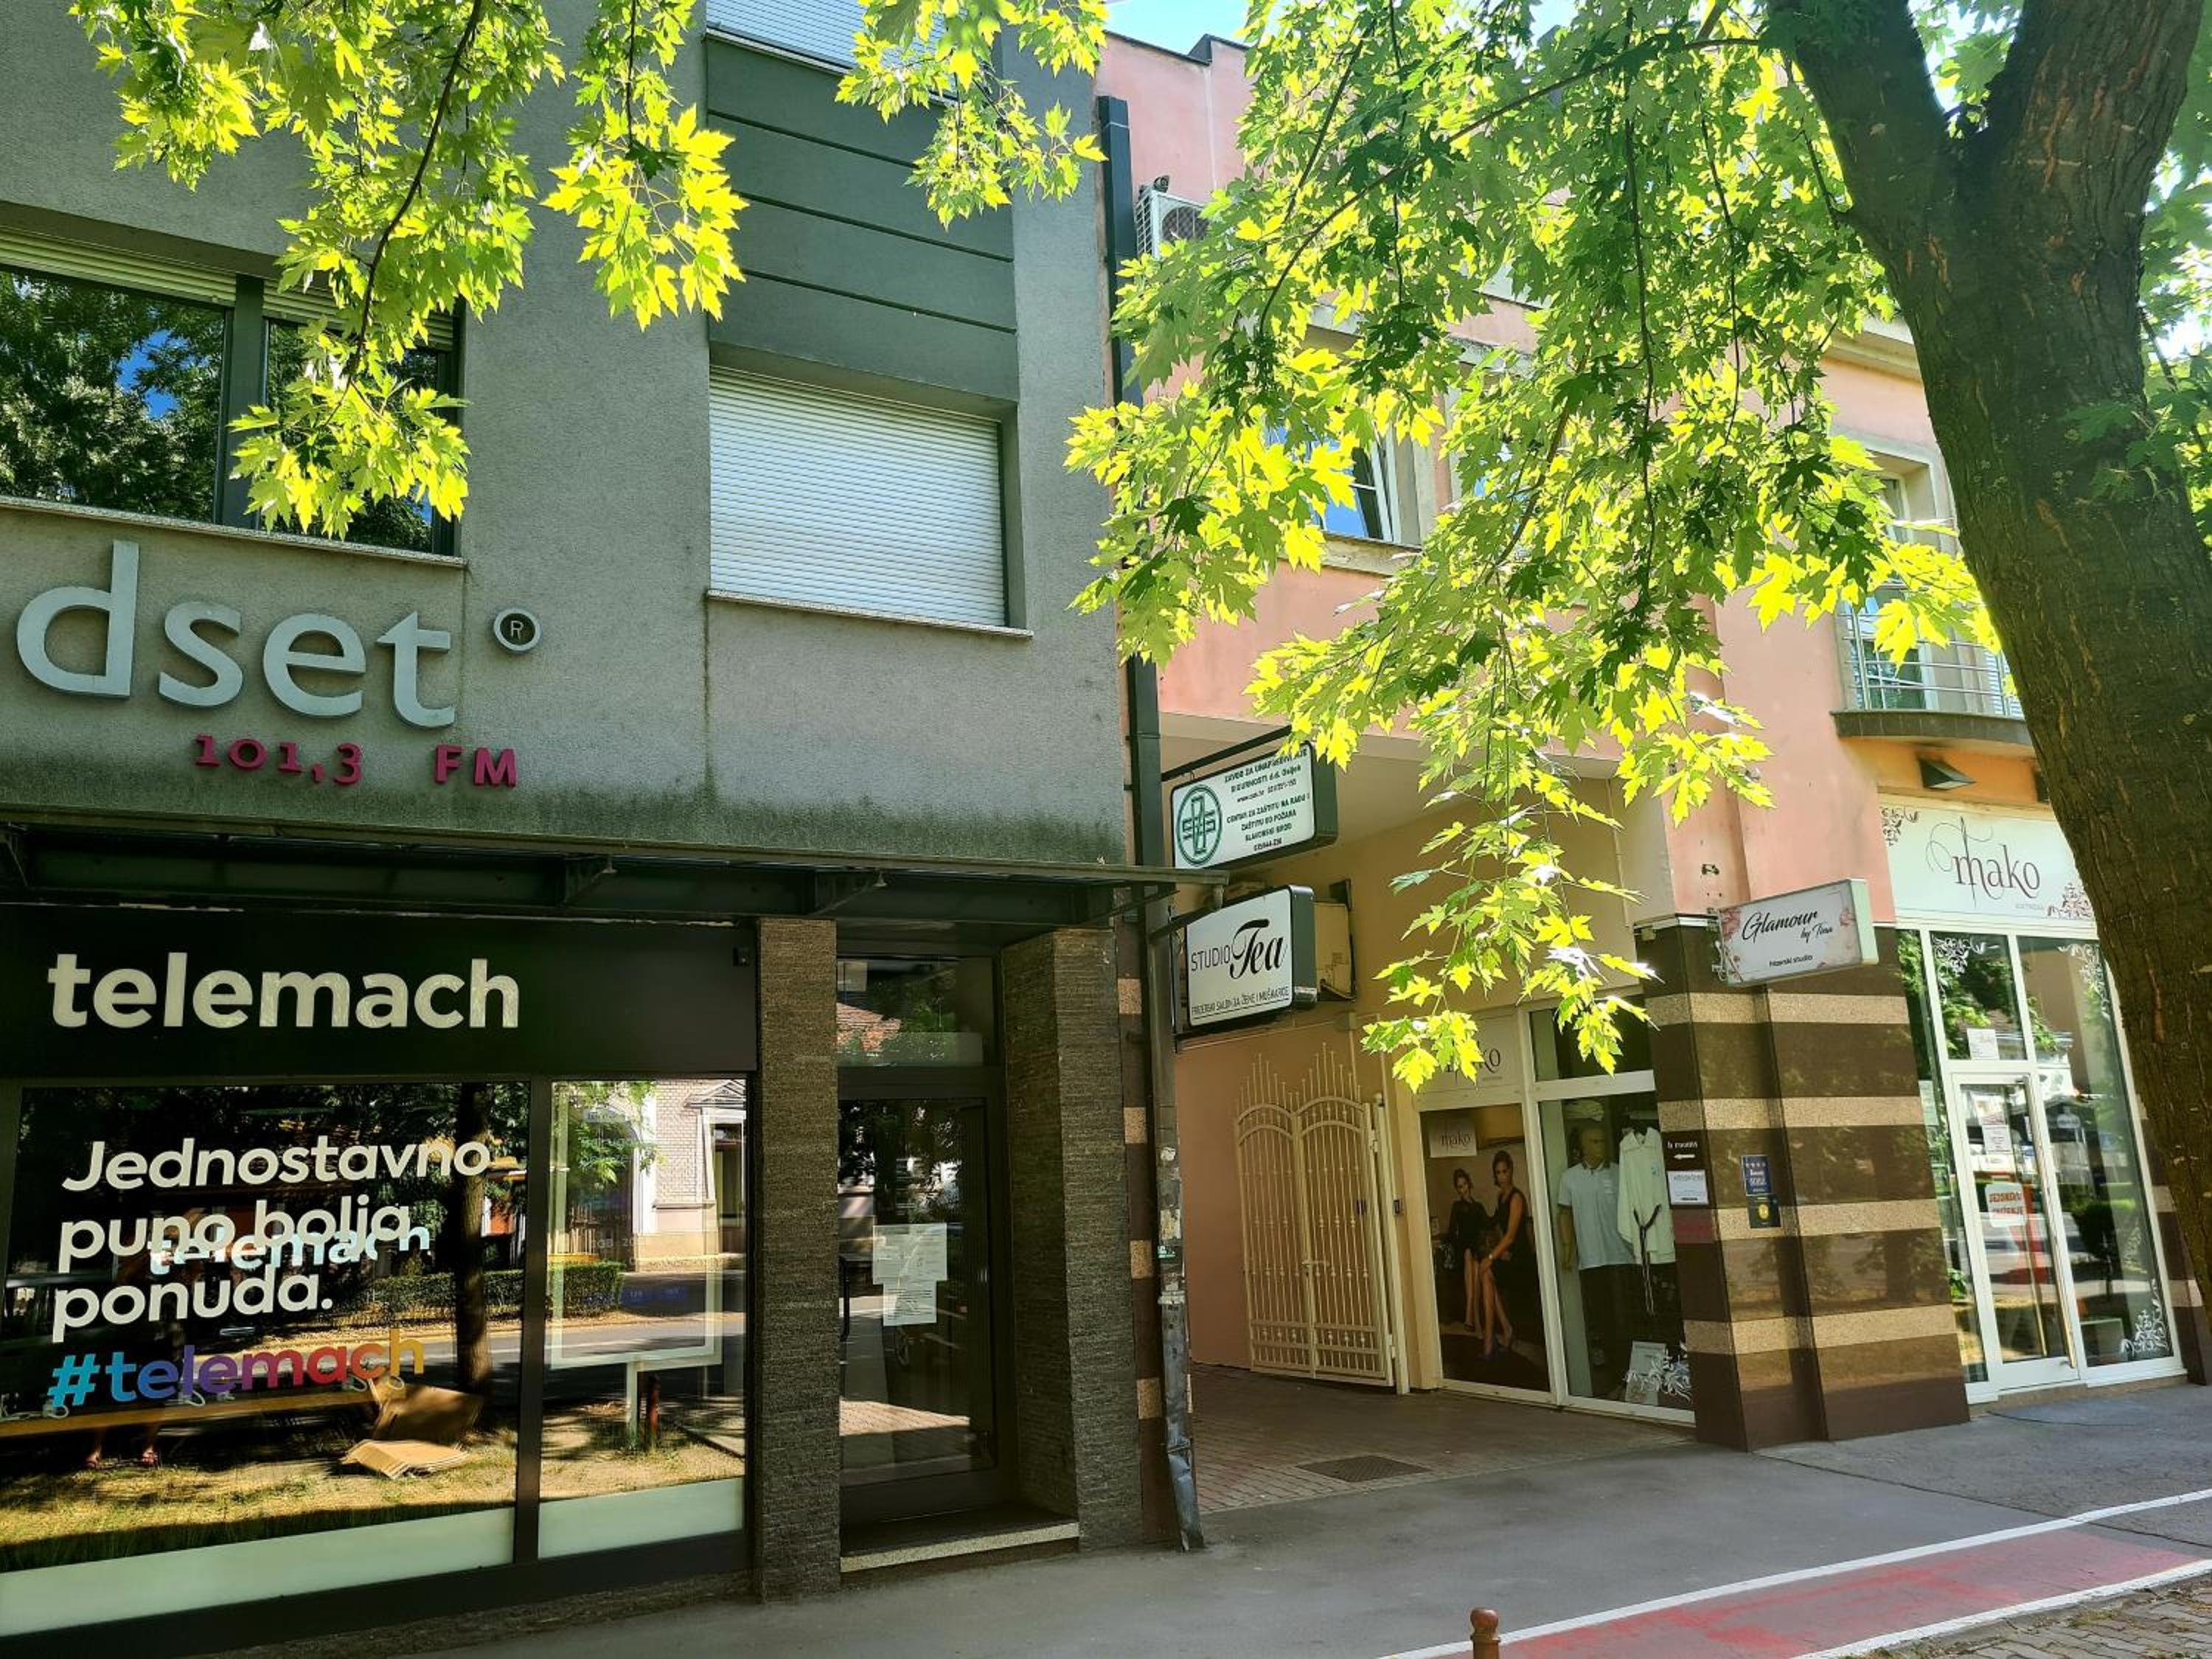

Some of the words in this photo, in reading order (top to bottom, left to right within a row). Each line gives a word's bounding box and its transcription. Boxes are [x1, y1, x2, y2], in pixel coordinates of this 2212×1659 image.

[16, 540, 456, 728] dset
[195, 734, 364, 786] 101,3
[434, 744, 516, 787] FM
[1245, 765, 1254, 777] ZA
[1248, 810, 1256, 818] ZA
[1281, 799, 1289, 808] NA
[1926, 816, 2040, 908] mako
[1191, 945, 1231, 972] STUDIO
[1229, 919, 1285, 979] Tea
[1742, 911, 1818, 944] Glamour
[1800, 928, 1812, 944] by
[48, 952, 519, 1029] telemach
[62, 1135, 491, 1192] Jednostavno
[58, 1214, 236, 1274] puno
[254, 1194, 411, 1256] bolja
[52, 1262, 333, 1344] ponuda.
[47, 1329, 425, 1409] #telemach
